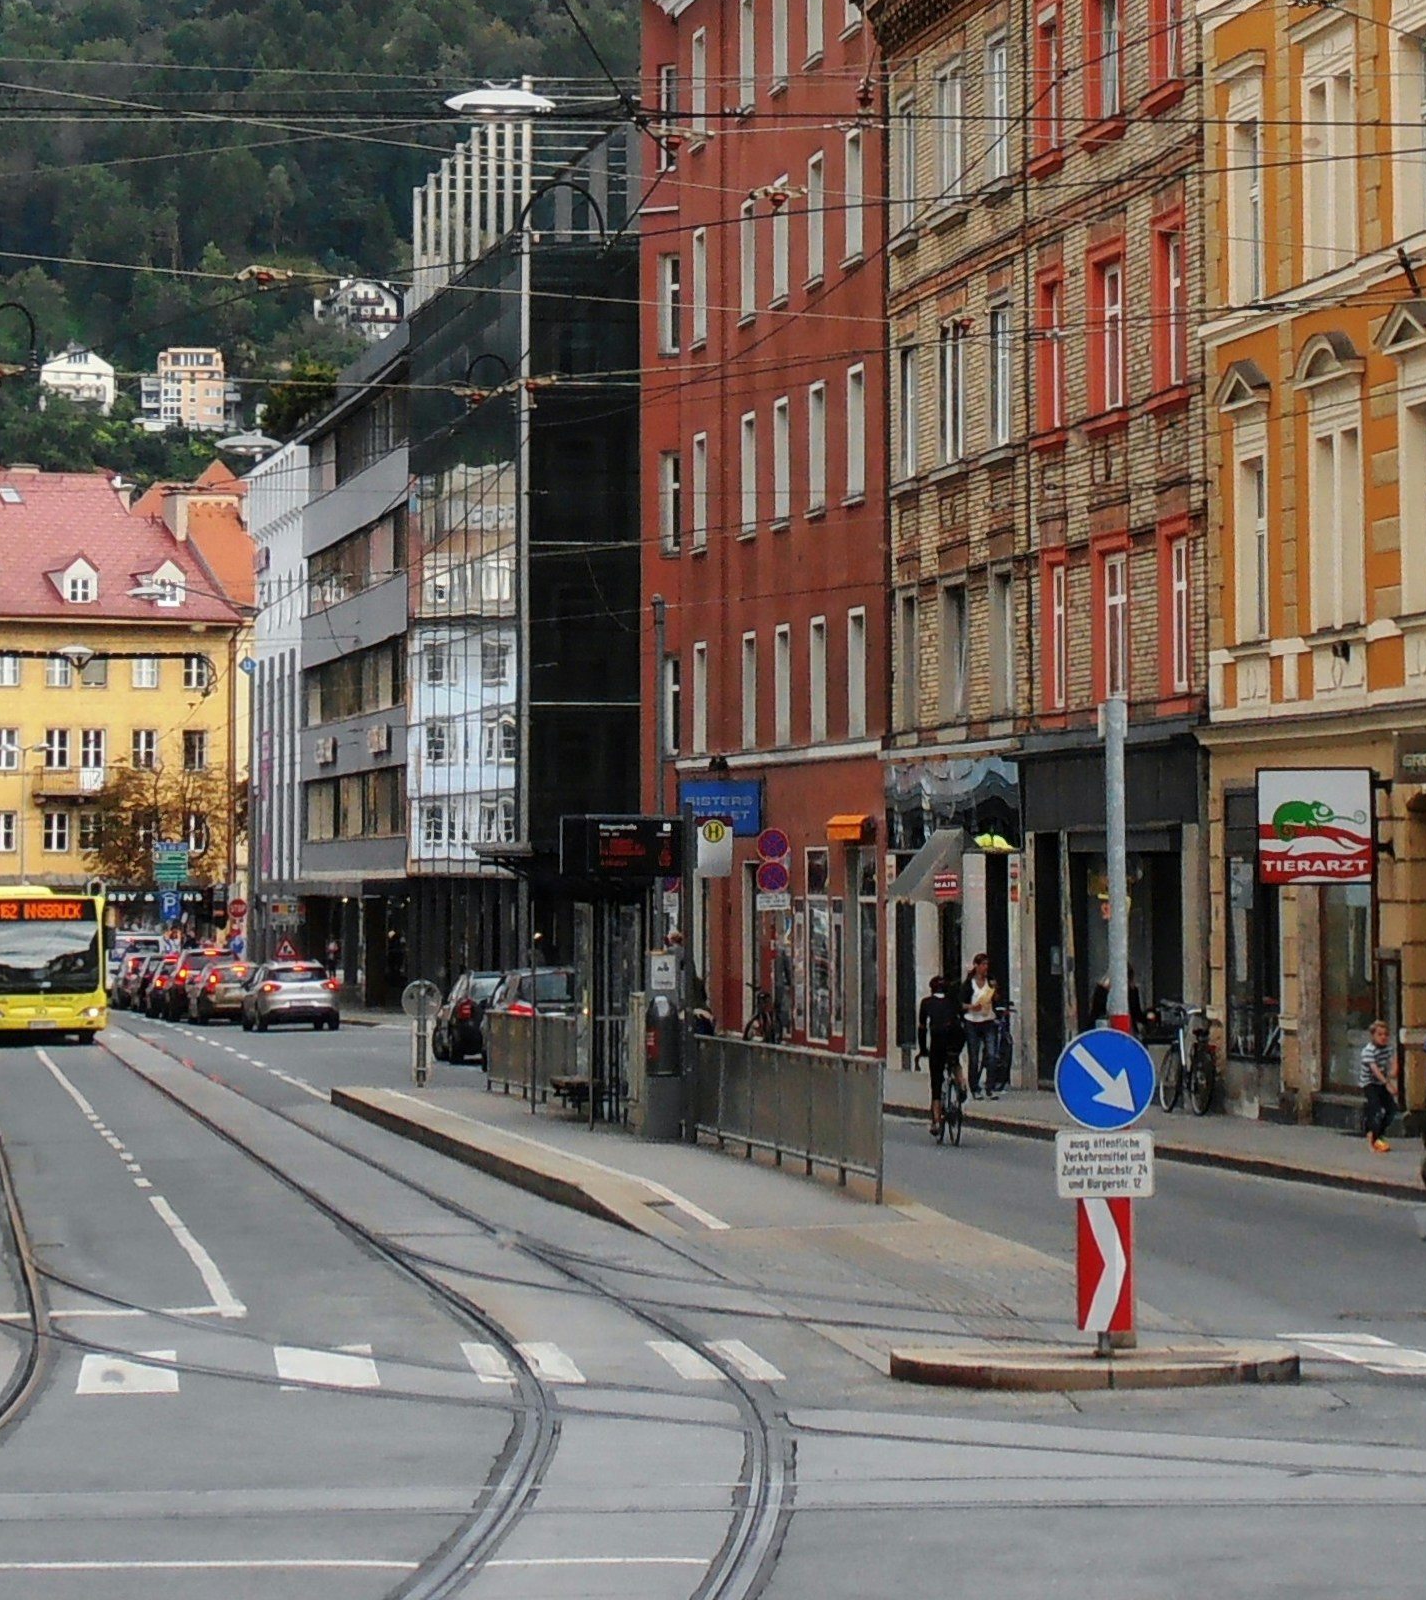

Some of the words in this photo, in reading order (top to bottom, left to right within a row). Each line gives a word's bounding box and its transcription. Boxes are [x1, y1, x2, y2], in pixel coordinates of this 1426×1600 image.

[685, 796, 753, 807] SISTERS
[708, 824, 719, 839] H
[1261, 859, 1369, 873] TIERARZT
[23, 902, 81, 919] INNSBRUCK
[229, 902, 247, 913] STOP
[1064, 1151, 1128, 1163] Verkehrsmittel
[1130, 1151, 1146, 1162] und
[1062, 1164, 1094, 1176] Zufahrt
[1137, 1163, 1148, 1175] 24
[1068, 1178, 1084, 1189] und
[1133, 1177, 1142, 1188] 12
